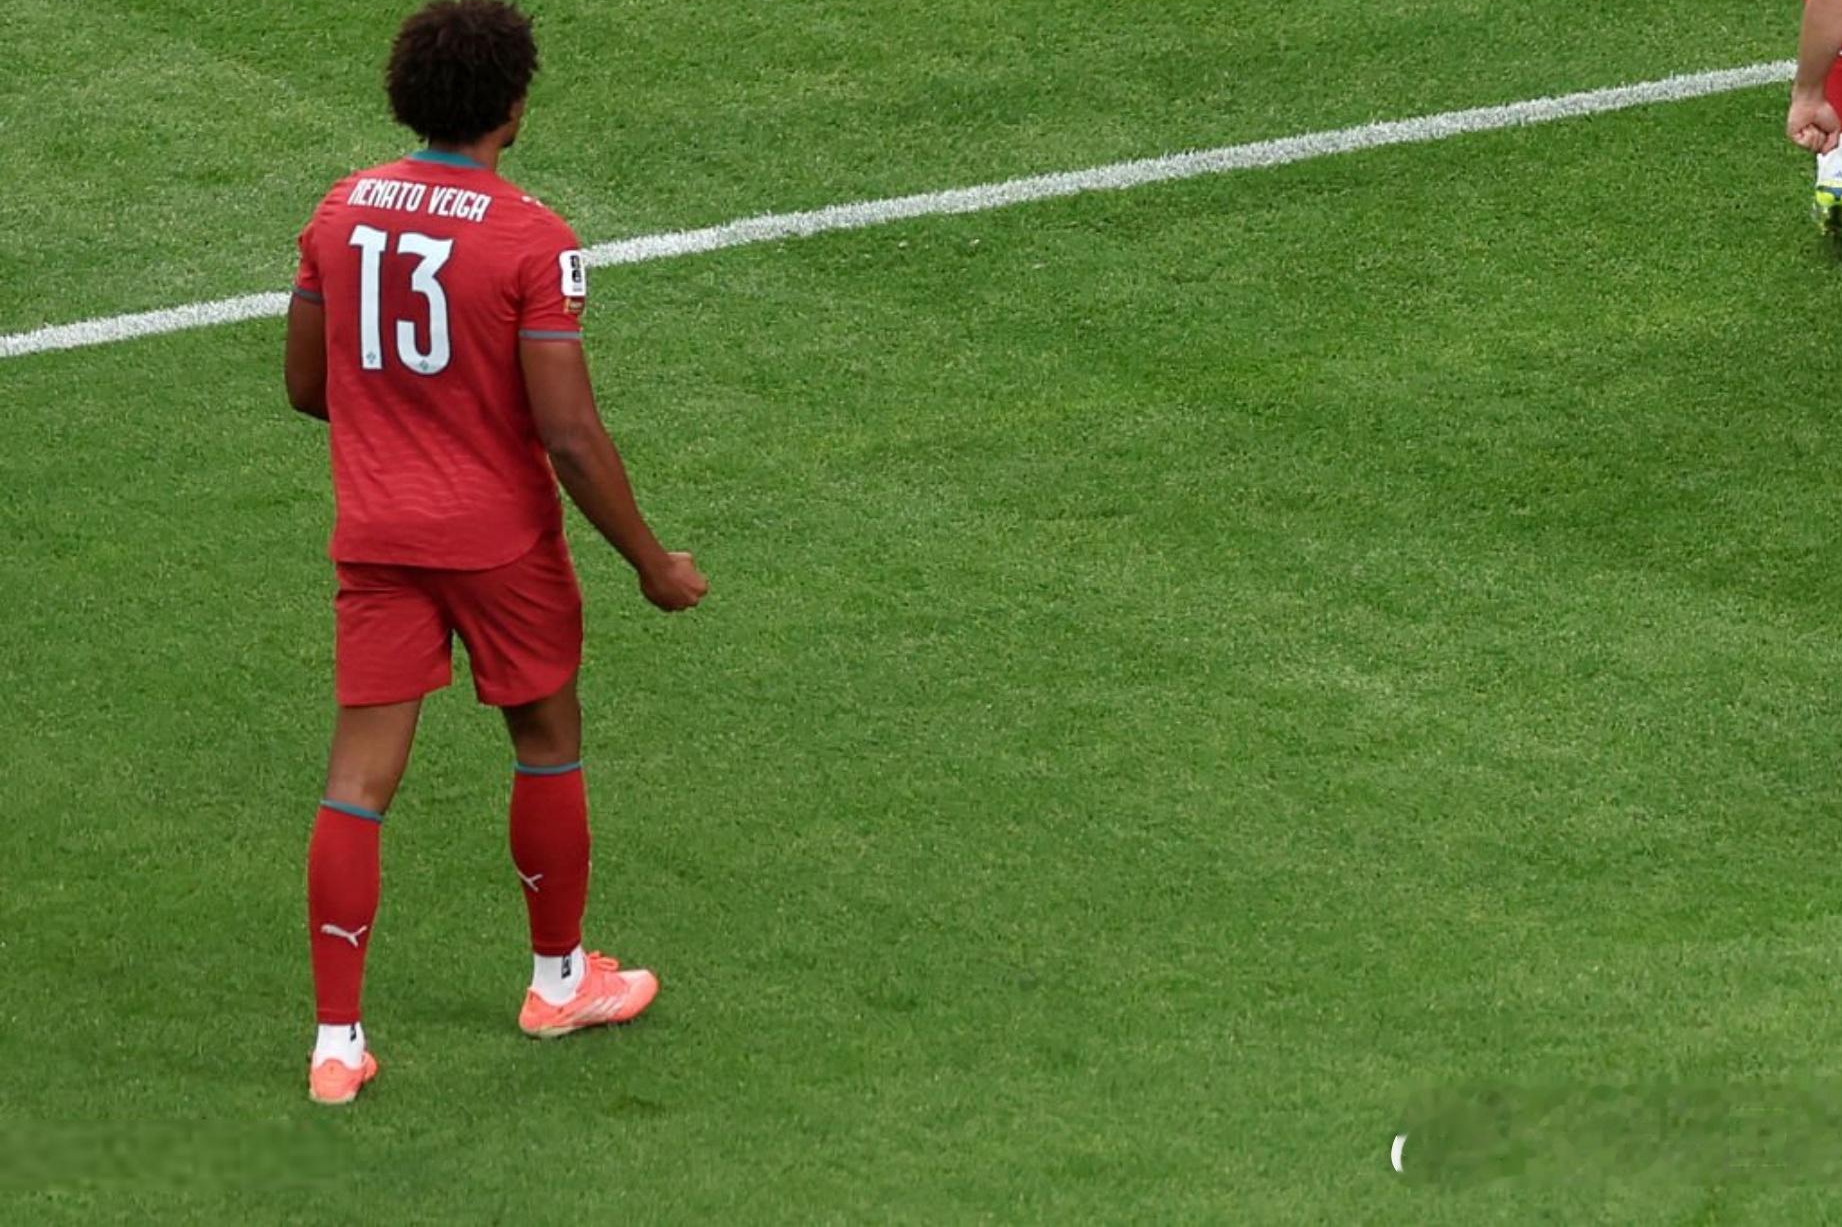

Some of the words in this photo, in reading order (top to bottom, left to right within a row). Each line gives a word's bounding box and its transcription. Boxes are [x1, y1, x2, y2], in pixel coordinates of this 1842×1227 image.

[346, 177, 427, 212] RENATO
[426, 185, 492, 223] VEIGA
[348, 224, 455, 375] 13
